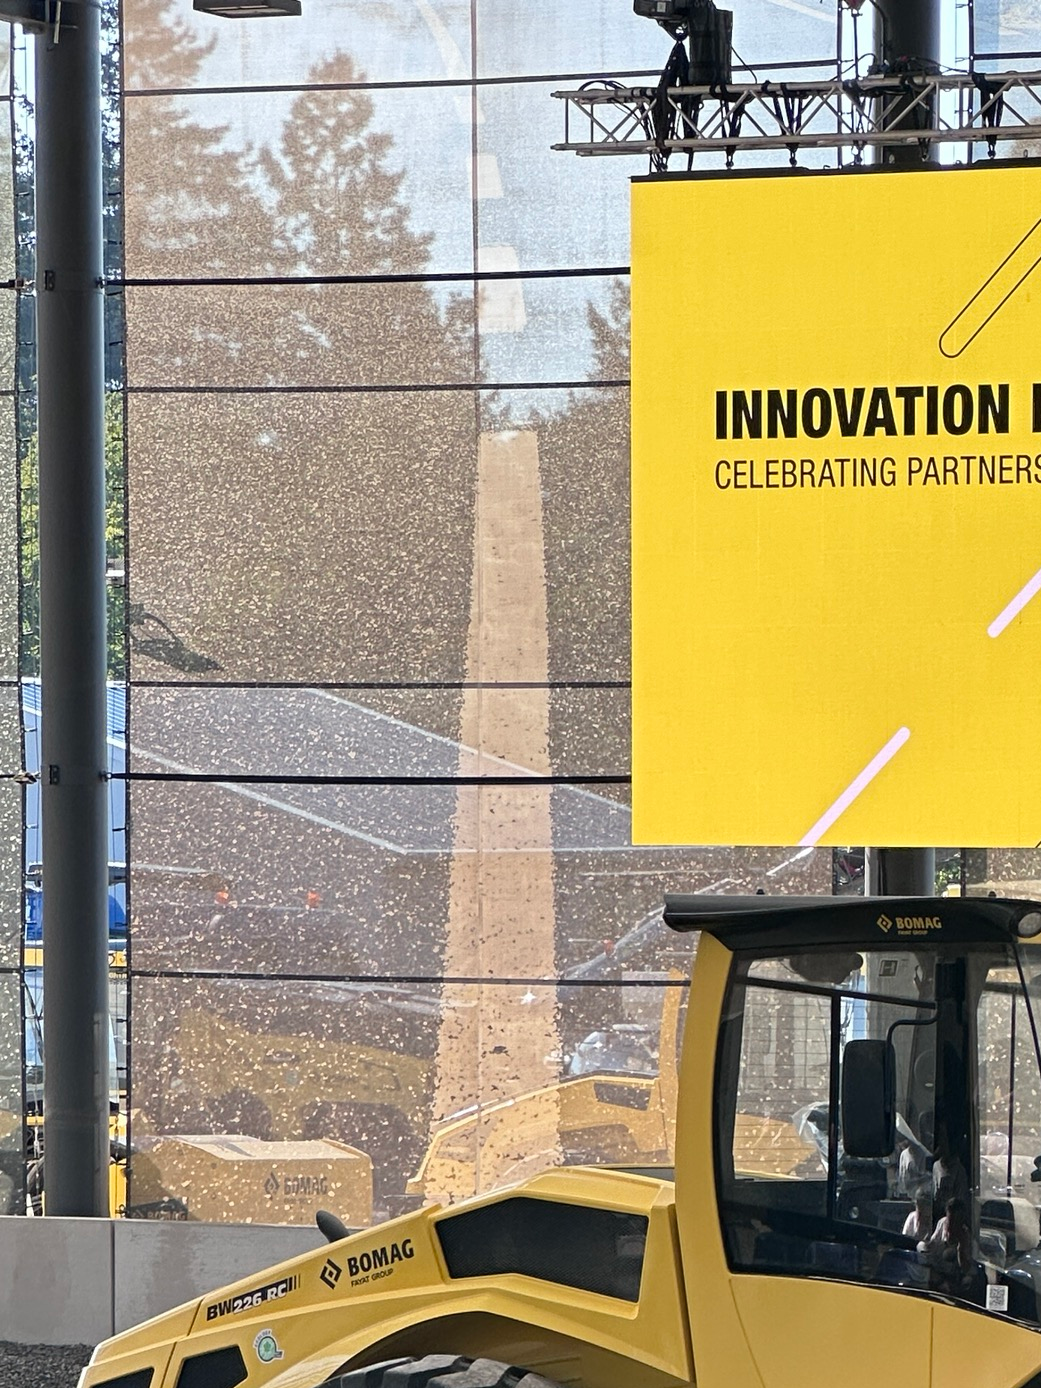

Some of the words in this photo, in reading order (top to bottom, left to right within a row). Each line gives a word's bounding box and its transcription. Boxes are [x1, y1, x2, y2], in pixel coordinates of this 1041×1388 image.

[715, 383, 1010, 440] INNOVATION
[715, 457, 897, 490] CELEBRATING
[895, 917, 942, 929] BOMAG
[283, 1173, 328, 1196] BOMAG
[347, 1239, 415, 1277] BOMAG
[351, 1275, 370, 1287] FAYAT
[371, 1268, 394, 1281] GROUP
